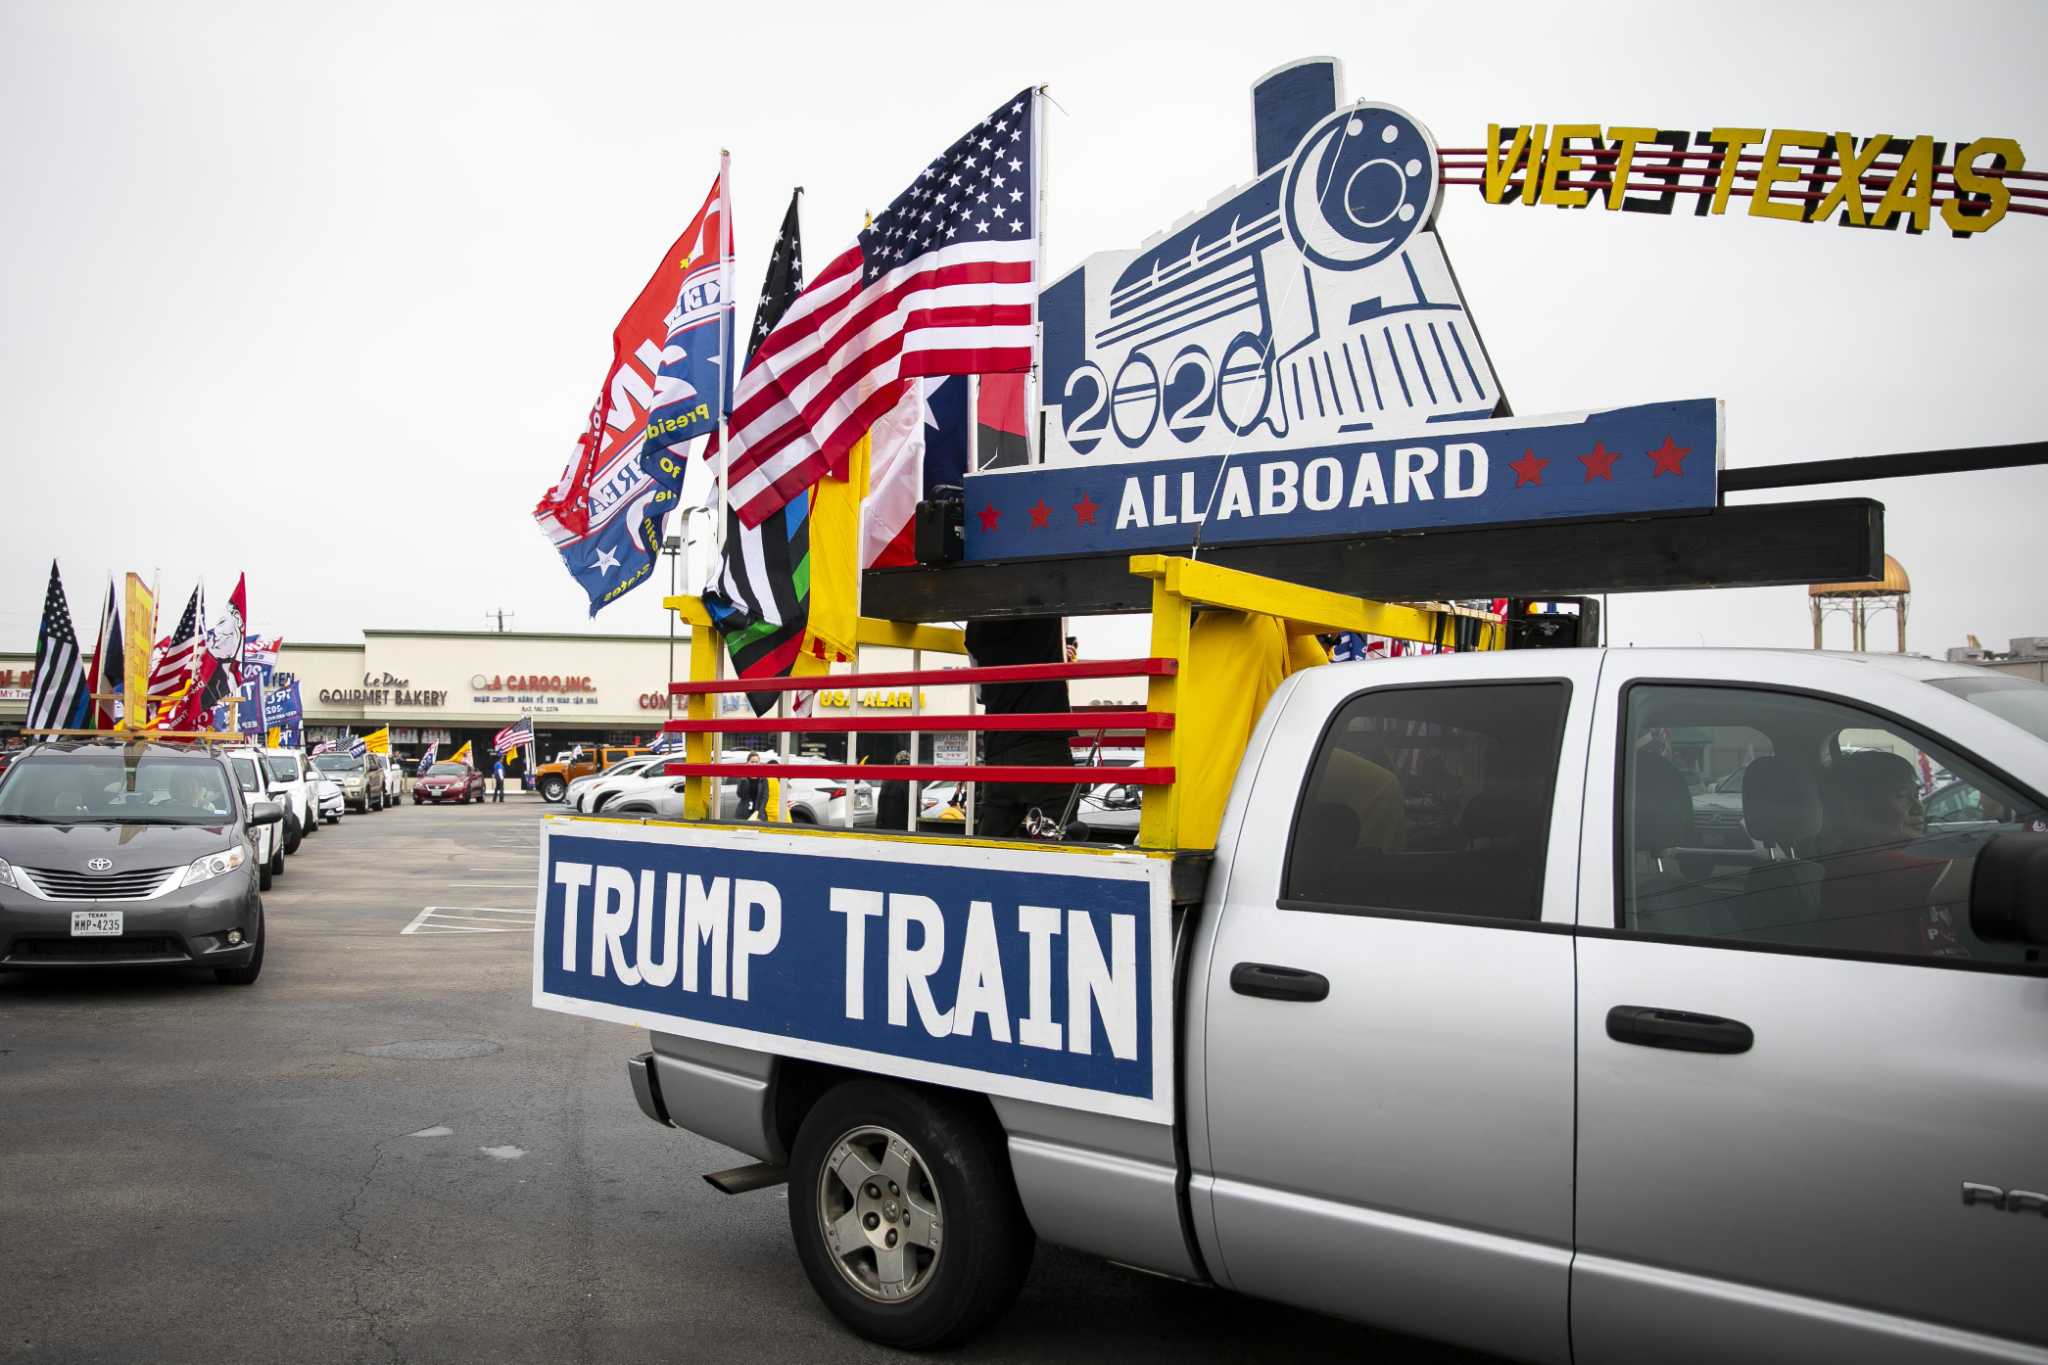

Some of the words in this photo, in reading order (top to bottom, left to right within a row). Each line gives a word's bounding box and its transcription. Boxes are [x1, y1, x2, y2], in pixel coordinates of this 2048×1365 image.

[1484, 123, 1658, 211] VIET
[1710, 127, 2026, 233] TEXAS
[1061, 330, 1274, 455] 2020
[1115, 471, 1206, 530] ALL
[1216, 442, 1490, 520] ABOARD
[319, 689, 390, 706] GOURMET
[395, 690, 448, 706] BAKERY
[554, 860, 782, 1002] TRUMP
[829, 886, 1138, 1062] TRAIN
